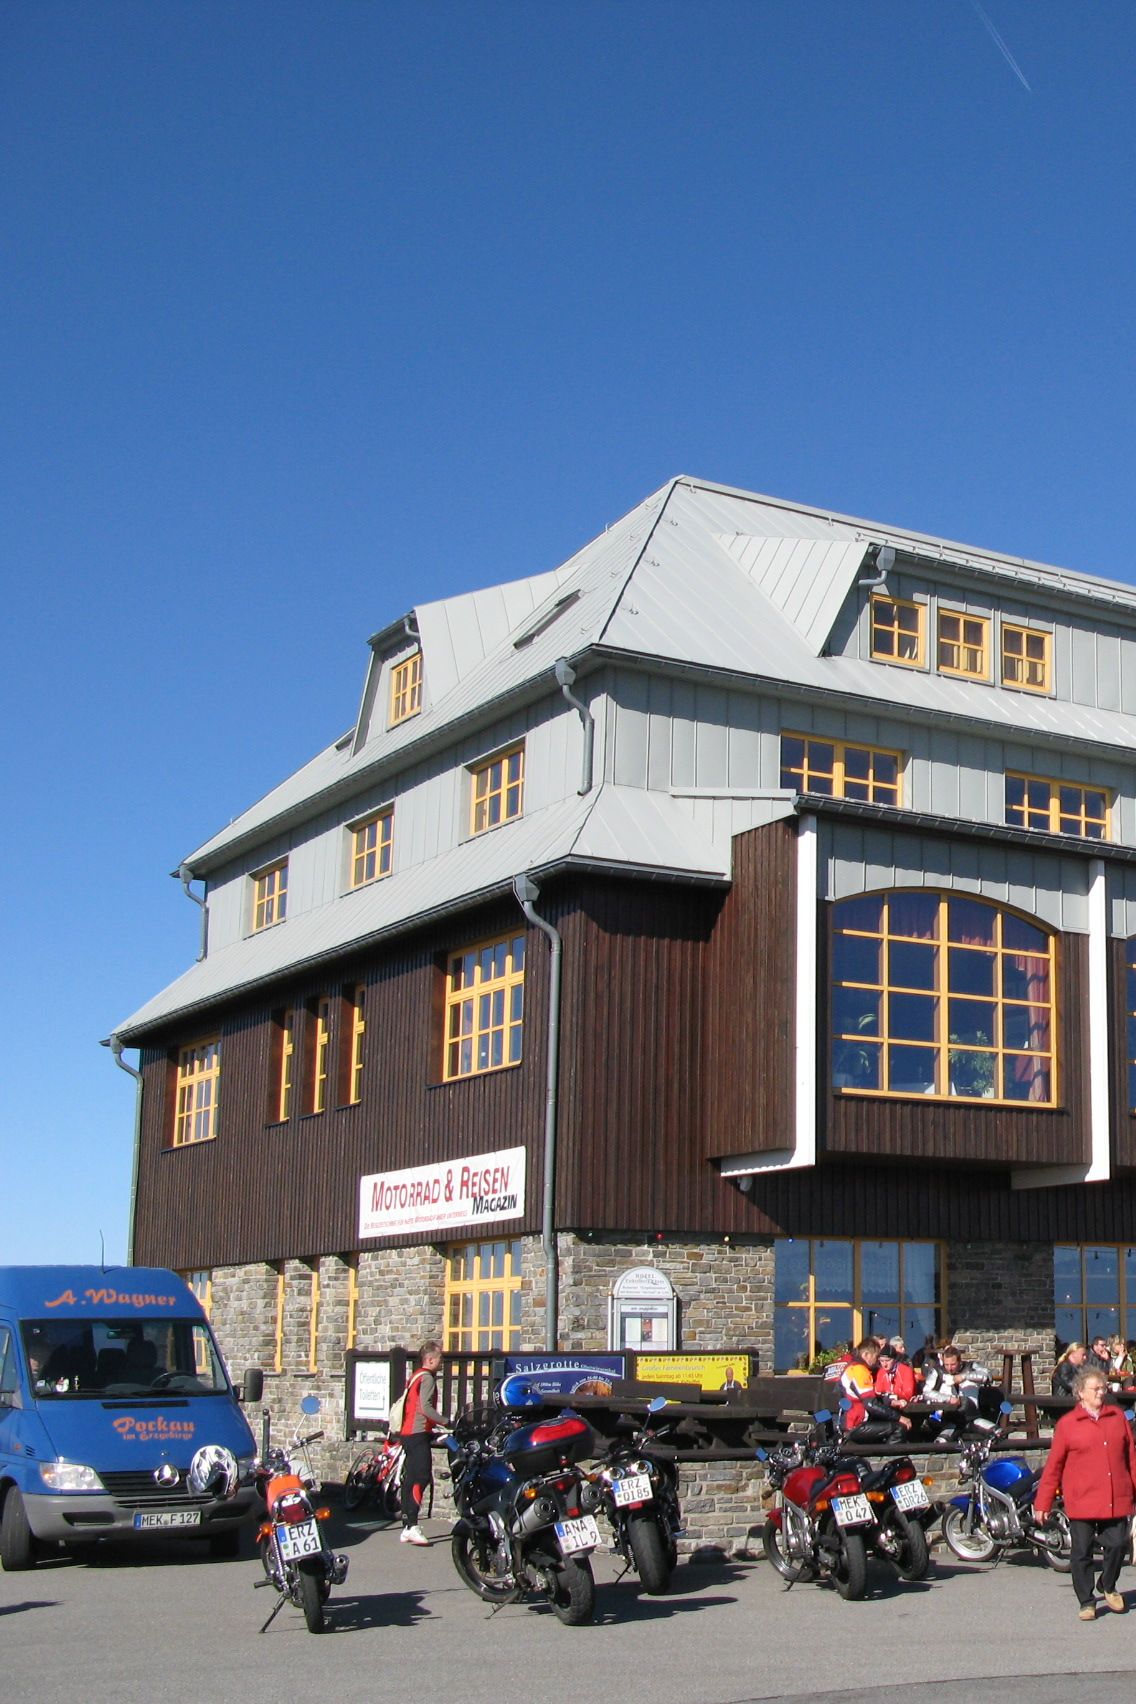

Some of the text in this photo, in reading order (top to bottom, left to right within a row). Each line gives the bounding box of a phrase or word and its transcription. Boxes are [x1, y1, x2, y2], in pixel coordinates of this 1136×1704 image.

[371, 1166, 511, 1212] MOTORRAD & REISEN
[471, 1193, 518, 1215] MAGAZIN
[515, 1360, 580, 1373] Salzgrotte
[112, 1415, 196, 1433] Pockau
[620, 1478, 642, 1492] ERZ
[898, 1482, 918, 1497] ERZ
[840, 1496, 861, 1510] MEK
[142, 1512, 199, 1525] MEK F 127
[855, 1507, 867, 1519] 47
[288, 1522, 314, 1541] ERZ
[565, 1520, 588, 1536] ANA
[293, 1537, 320, 1555] A 61
